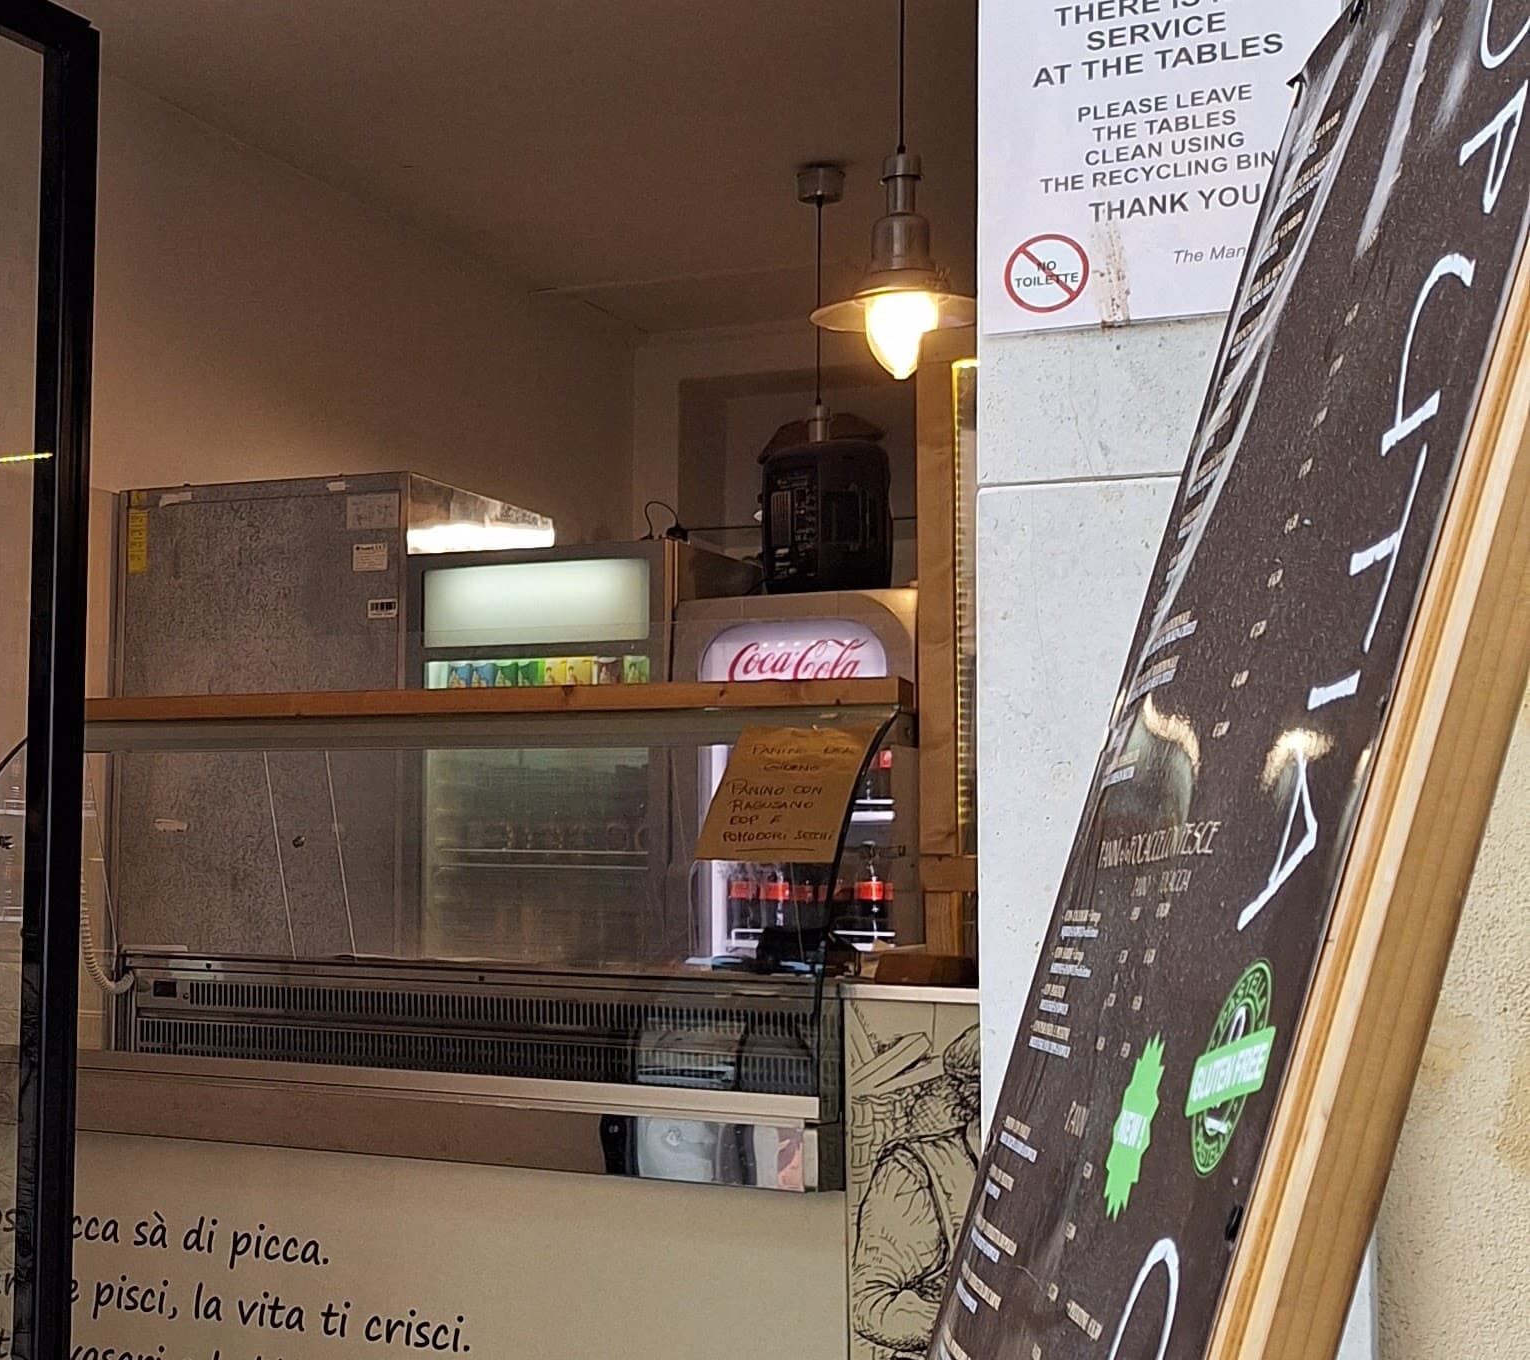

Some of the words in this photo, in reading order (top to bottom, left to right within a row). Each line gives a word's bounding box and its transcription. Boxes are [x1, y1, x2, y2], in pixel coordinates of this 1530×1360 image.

[1086, 11, 1227, 51] SERVICE
[1032, 63, 1072, 89] AT
[1081, 53, 1144, 82] THE
[1154, 32, 1284, 71] TABLES
[1077, 95, 1168, 123] PLEASE
[1176, 84, 1253, 110] LEAVE
[1092, 123, 1137, 144] THE
[1145, 109, 1237, 137] TABLES
[1084, 142, 1165, 167] CLEAN
[1171, 131, 1245, 157] USING
[1040, 174, 1084, 195] THE
[1091, 157, 1229, 188] RECYCLING
[1089, 191, 1189, 223] THANK
[1198, 183, 1261, 210] YOU
[1036, 260, 1057, 273] NO
[1173, 249, 1205, 265] The
[1209, 245, 1247, 262] Man
[1014, 271, 1079, 289] TOILETTE
[728, 638, 869, 681] Coca-Cola
[726, 779, 785, 796] PANINO
[792, 785, 823, 795] CON
[730, 799, 815, 813] RAGUSANO
[133, 1210, 169, 1248] sà
[182, 1218, 214, 1254] di
[228, 1222, 331, 1268] picca.
[92, 1275, 181, 1320] pisci,
[192, 1282, 223, 1323] la
[236, 1291, 306, 1334] vita
[320, 1300, 349, 1338] ti
[364, 1307, 472, 1353] crisci.
